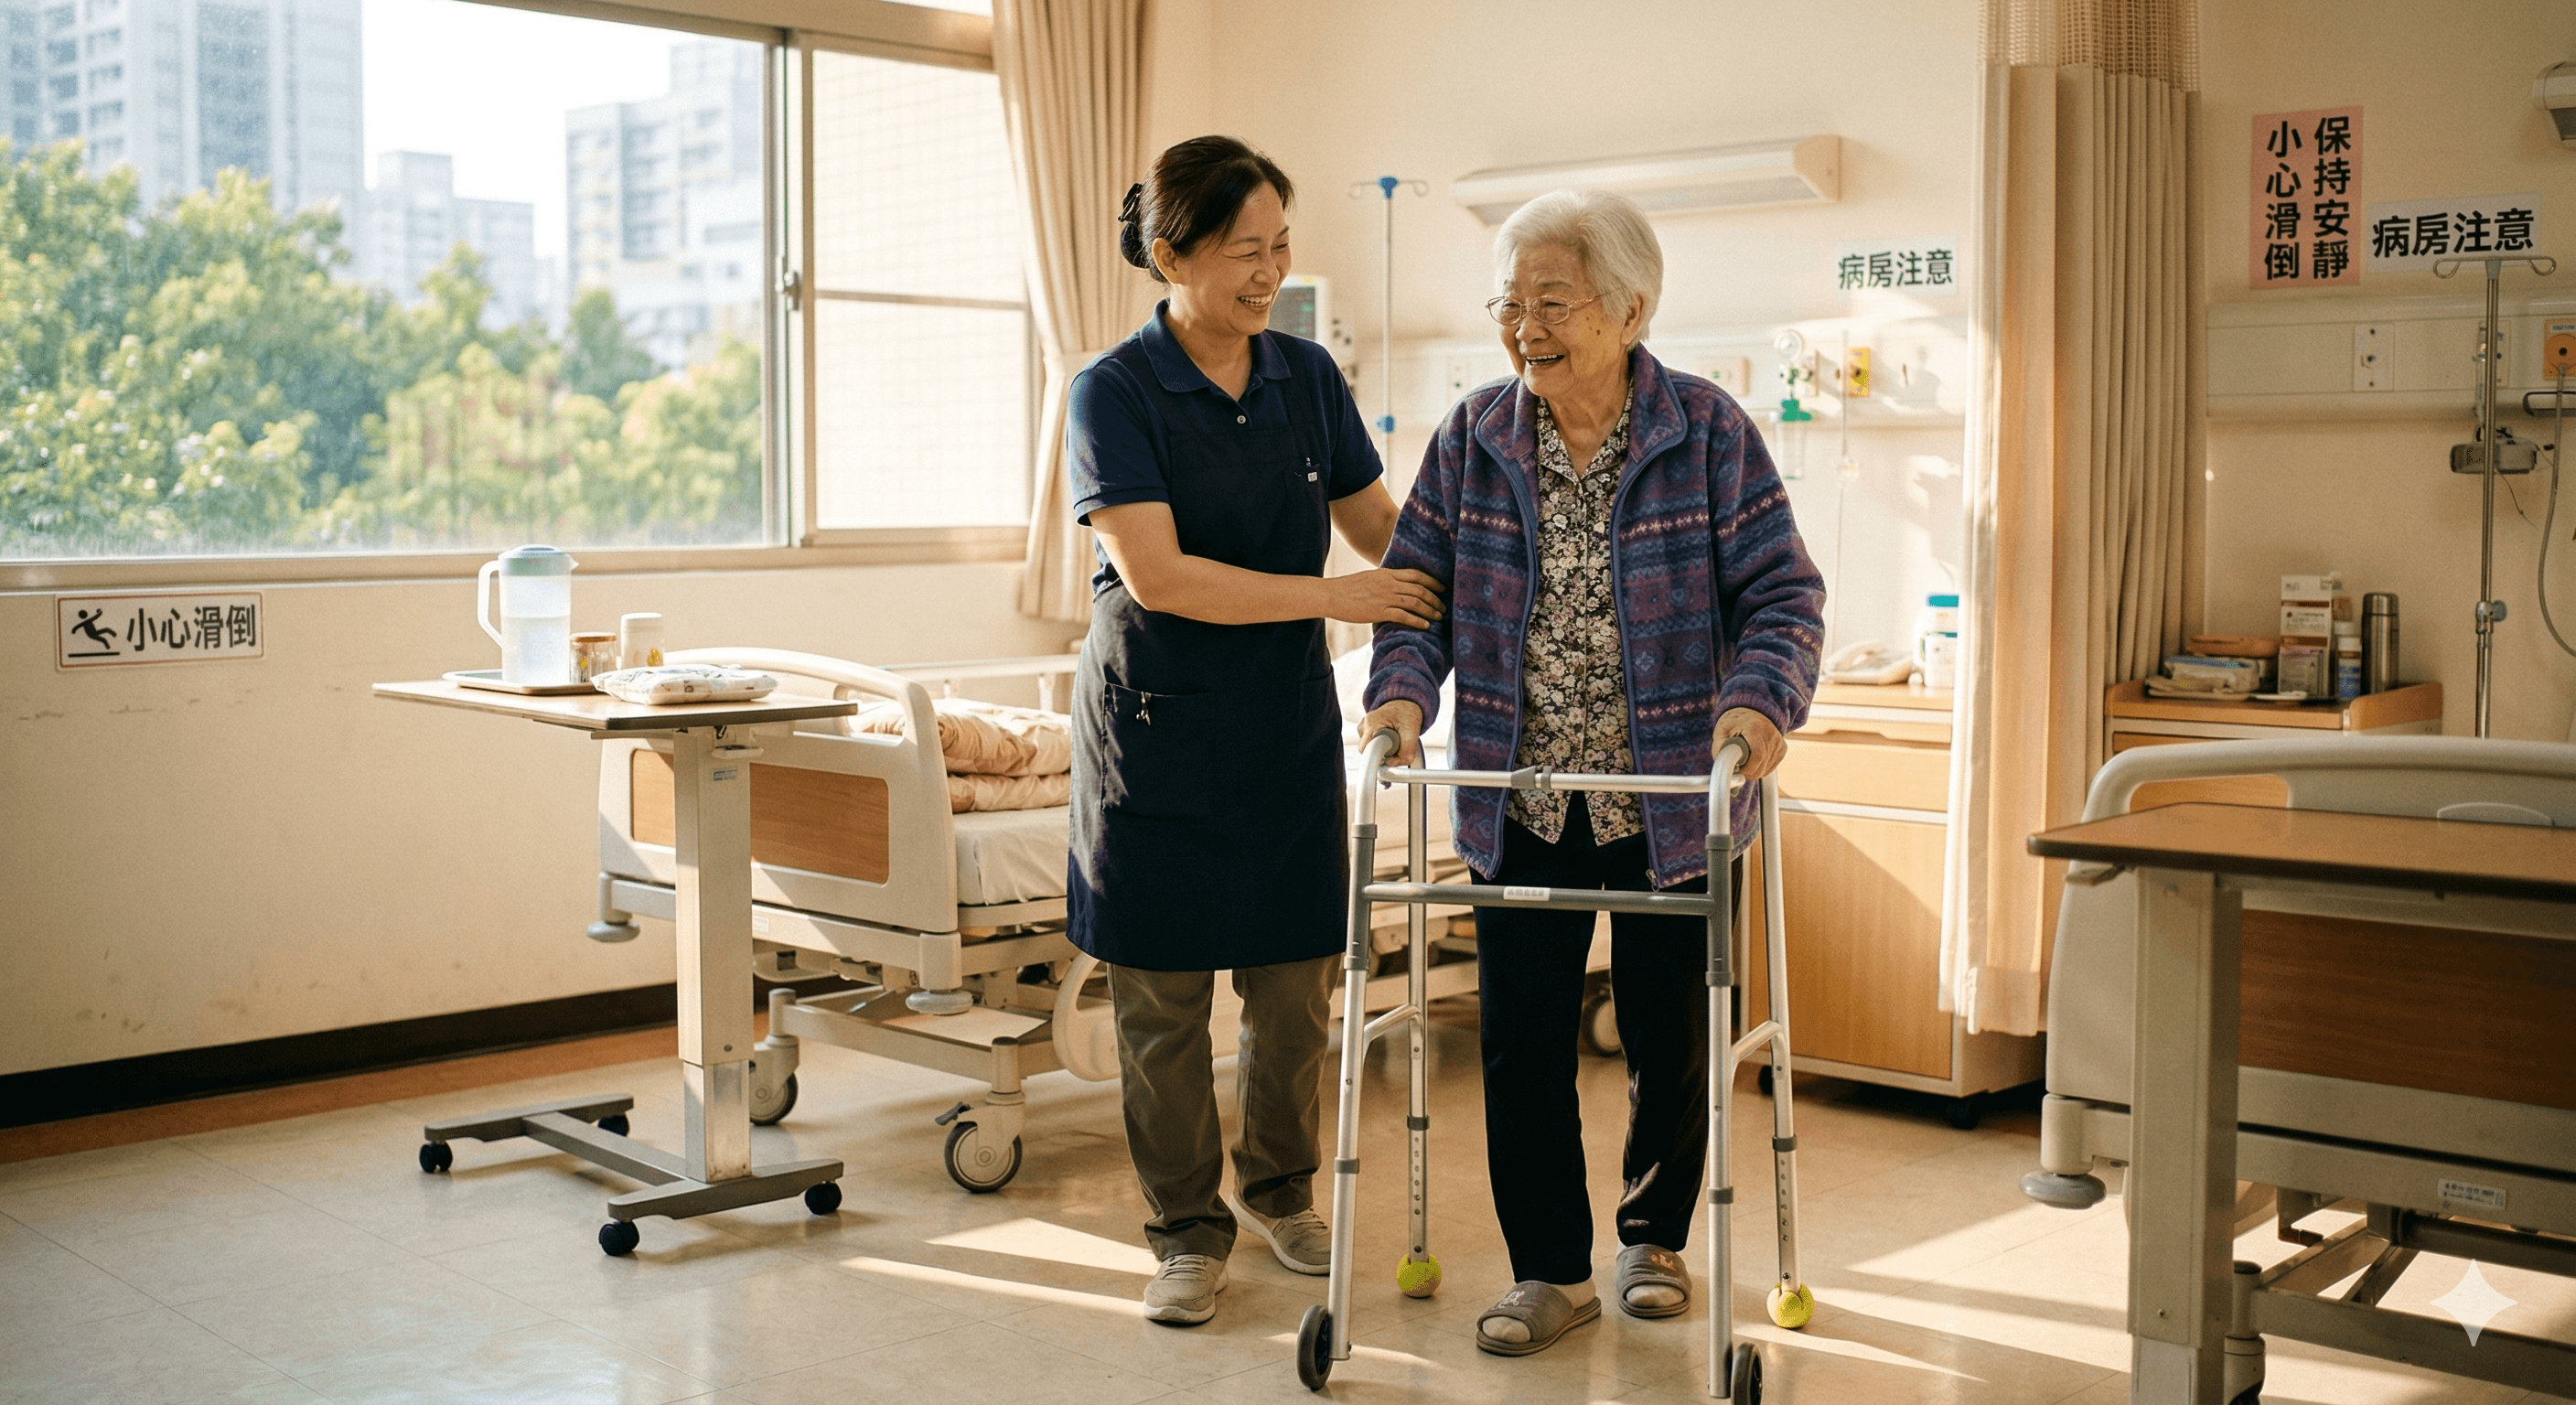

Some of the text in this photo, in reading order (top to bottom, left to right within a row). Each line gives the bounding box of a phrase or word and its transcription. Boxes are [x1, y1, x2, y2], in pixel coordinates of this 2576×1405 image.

[2264, 120, 2302, 280] 小心滑倒
[2313, 115, 2352, 280] 保持安靜
[2372, 208, 2535, 258] 病房注意
[1839, 249, 1953, 289] 病房注意
[126, 604, 256, 651] 小心滑倒
